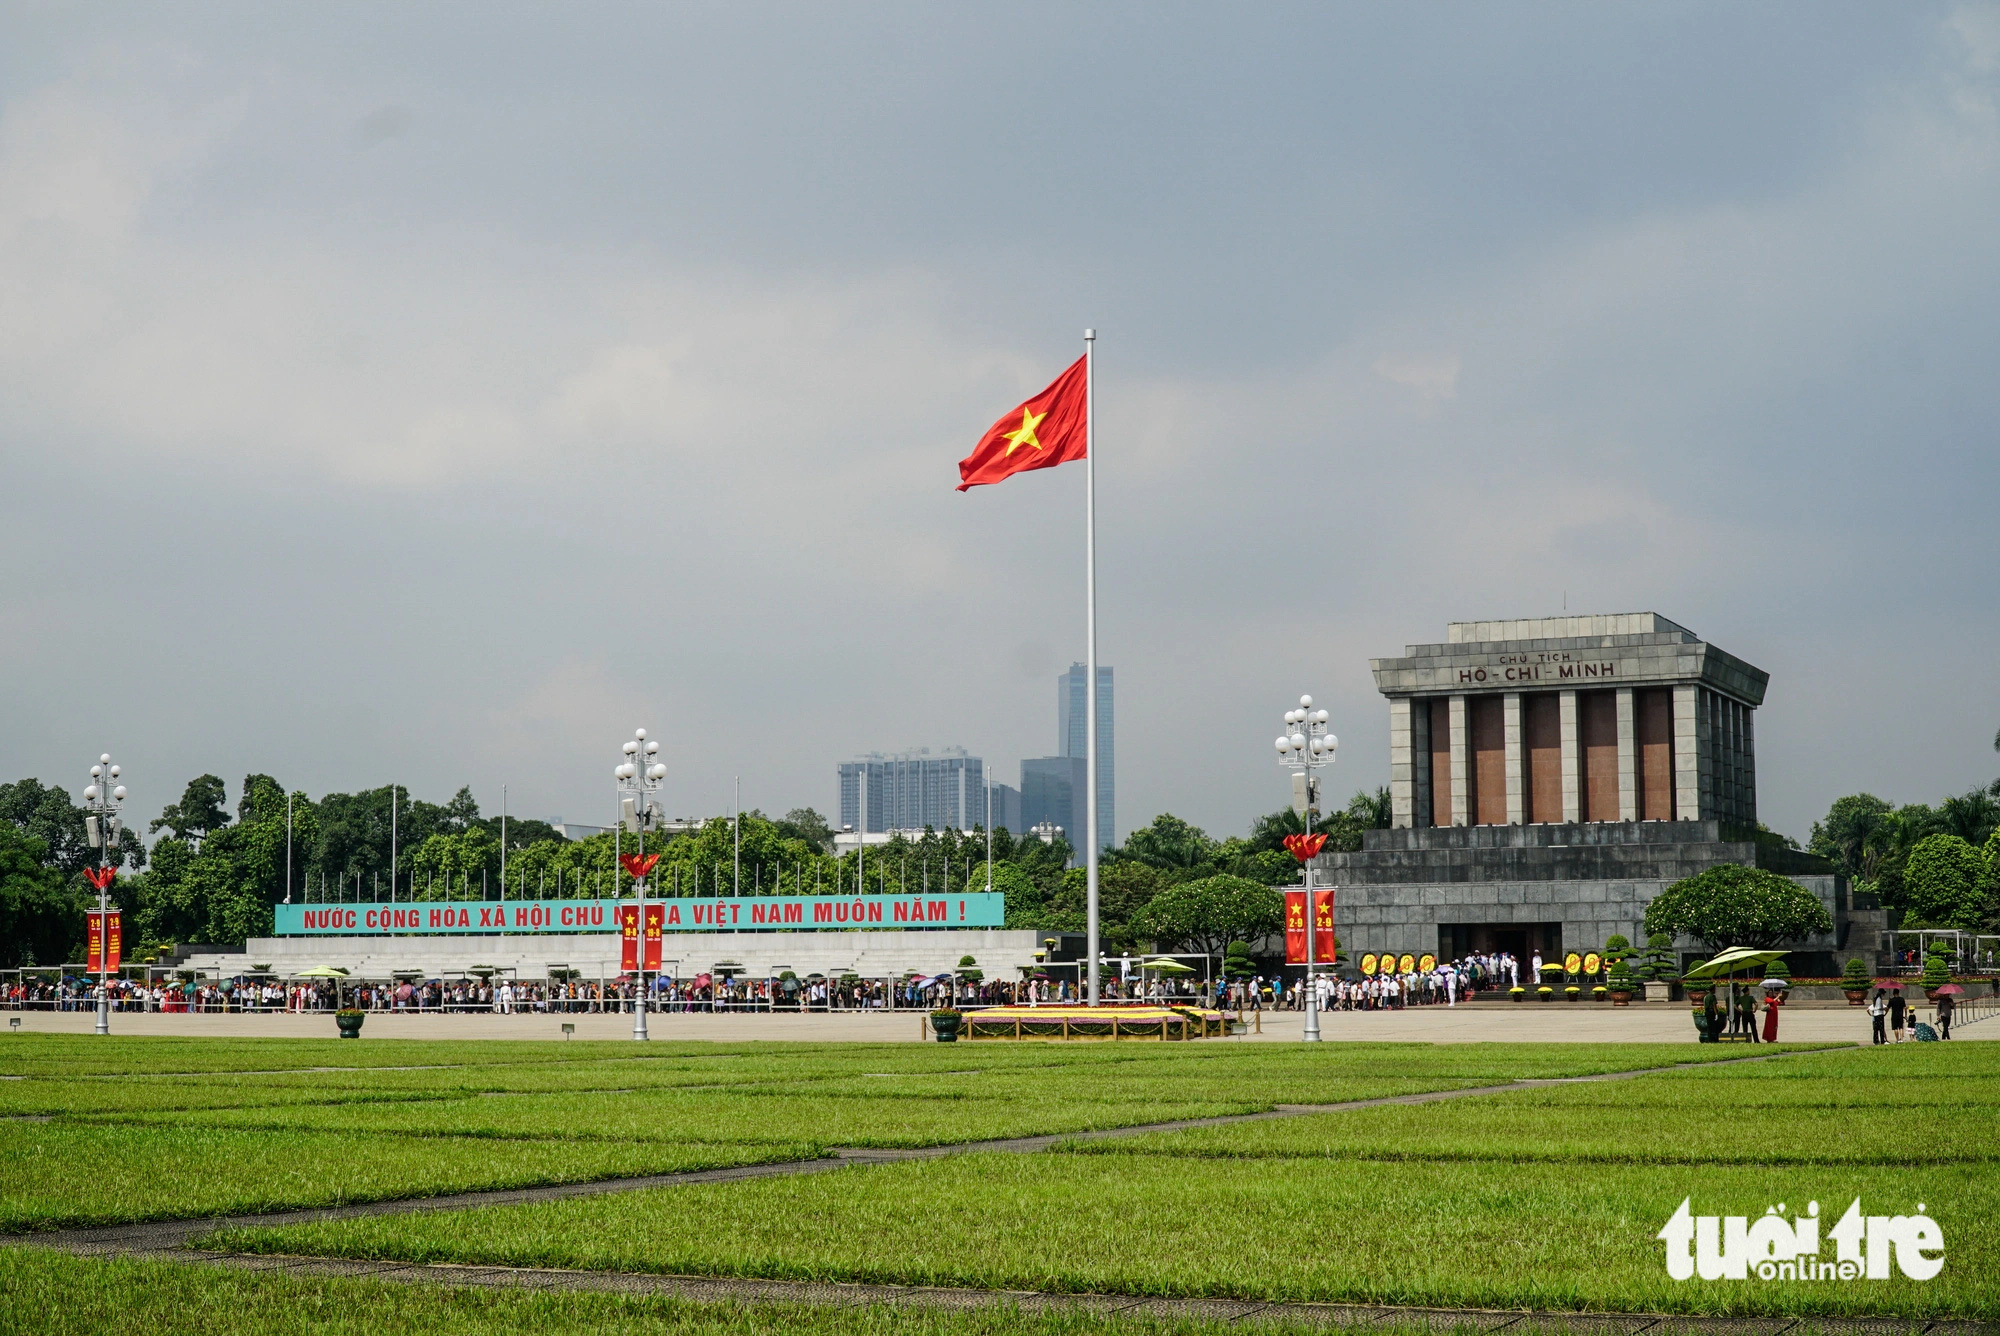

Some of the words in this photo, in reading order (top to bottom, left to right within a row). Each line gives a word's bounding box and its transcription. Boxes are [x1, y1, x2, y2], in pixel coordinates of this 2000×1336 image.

[1559, 660, 1615, 678] MINH
[303, 907, 357, 929] NƯỚC
[365, 905, 420, 932] CỘNG
[429, 905, 471, 928] HÒA
[479, 904, 507, 927] XÃ
[515, 903, 551, 931] HỘI
[560, 900, 604, 927] CHỦ
[691, 900, 741, 928] VIỆT
[751, 903, 803, 924] NAM
[813, 898, 883, 924] MUÔN
[893, 897, 947, 923] NĂM
[1316, 917, 1332, 927] 2-9
